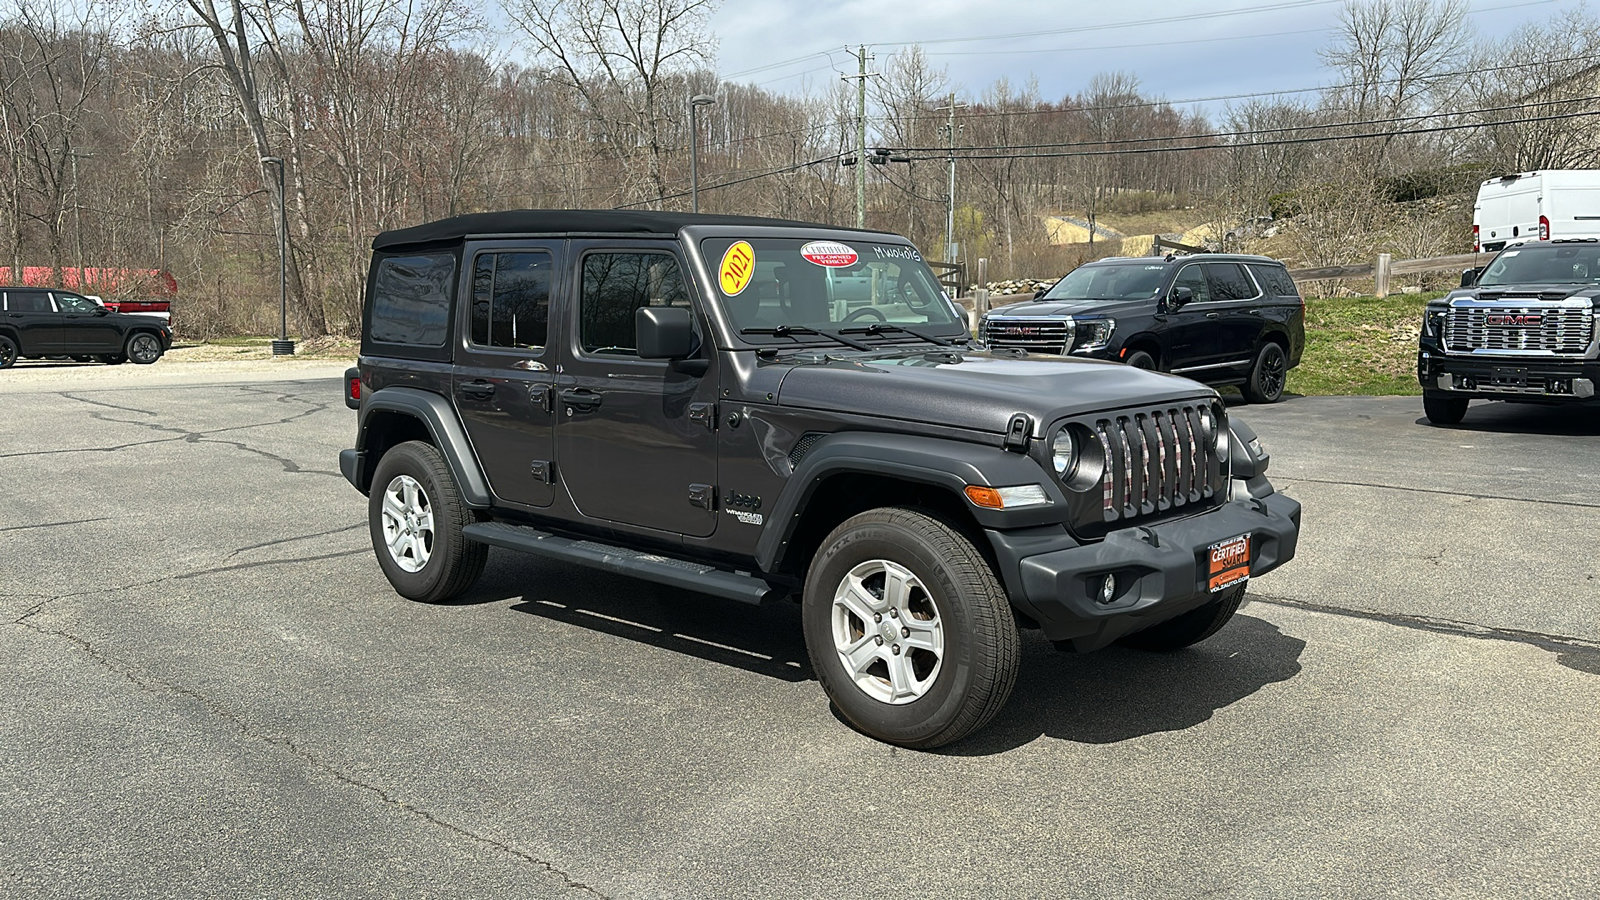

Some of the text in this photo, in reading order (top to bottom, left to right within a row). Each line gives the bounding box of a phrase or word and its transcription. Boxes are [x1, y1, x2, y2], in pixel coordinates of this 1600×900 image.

[804, 246, 850, 254] CERTIFIED
[725, 247, 750, 289] 2021
[1488, 315, 1542, 325] GMC
[1005, 327, 1039, 335] GMC
[724, 489, 762, 511] Jeep
[1212, 540, 1246, 562] CERTIFIED
[1222, 554, 1244, 569] SMART
